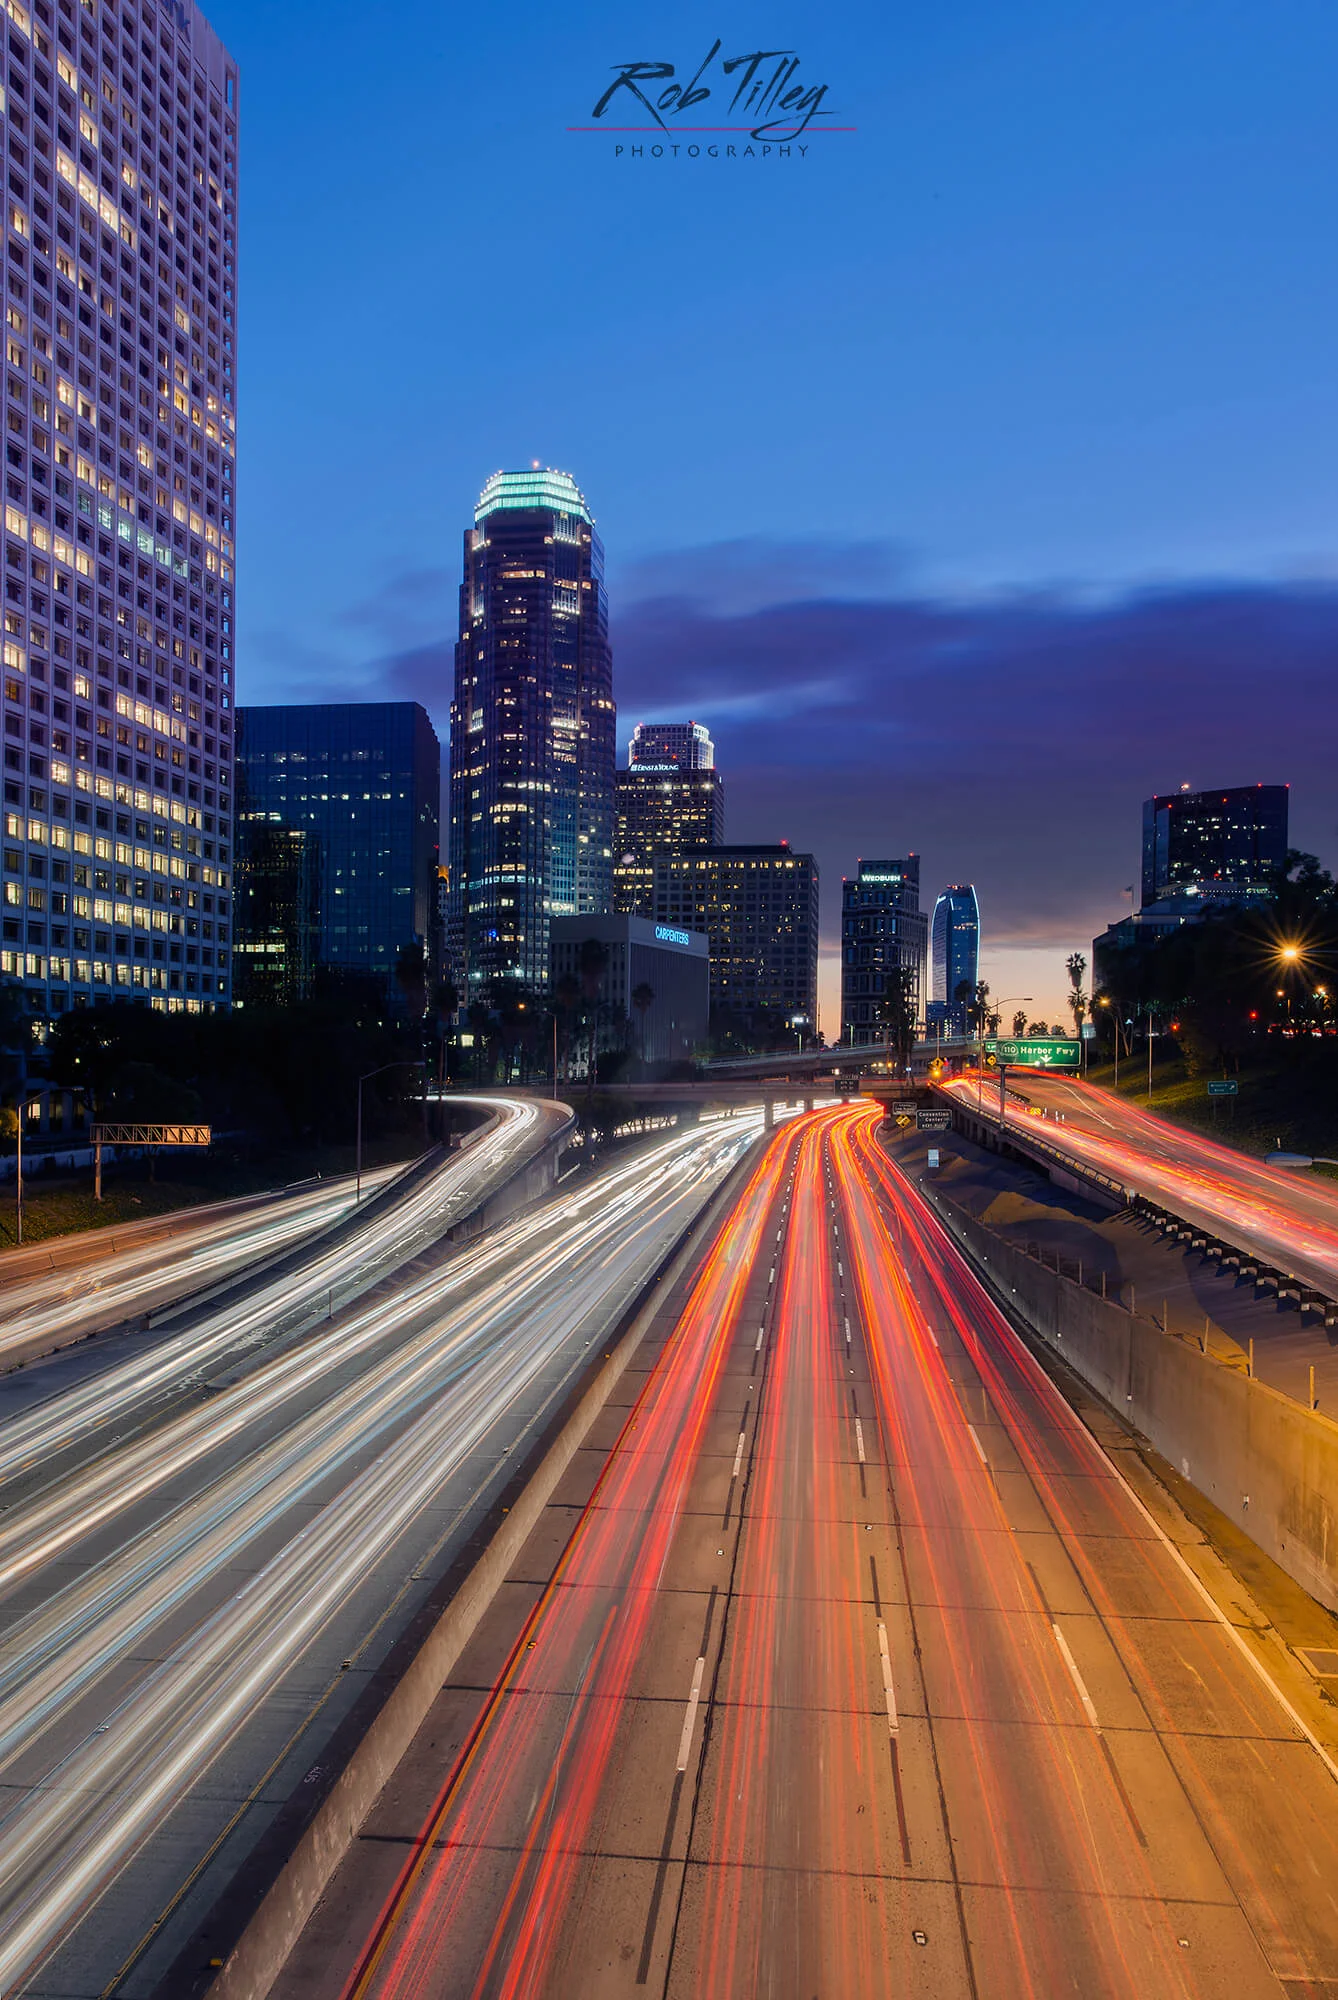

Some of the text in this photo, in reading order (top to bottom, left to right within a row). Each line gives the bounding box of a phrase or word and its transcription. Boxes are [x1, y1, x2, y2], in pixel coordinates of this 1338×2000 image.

[861, 874, 901, 882] WEDBUSH
[655, 925, 689, 946] CARPENTERS
[1020, 1046, 1052, 1055] Harbor
[1056, 1047, 1075, 1056] Fwy
